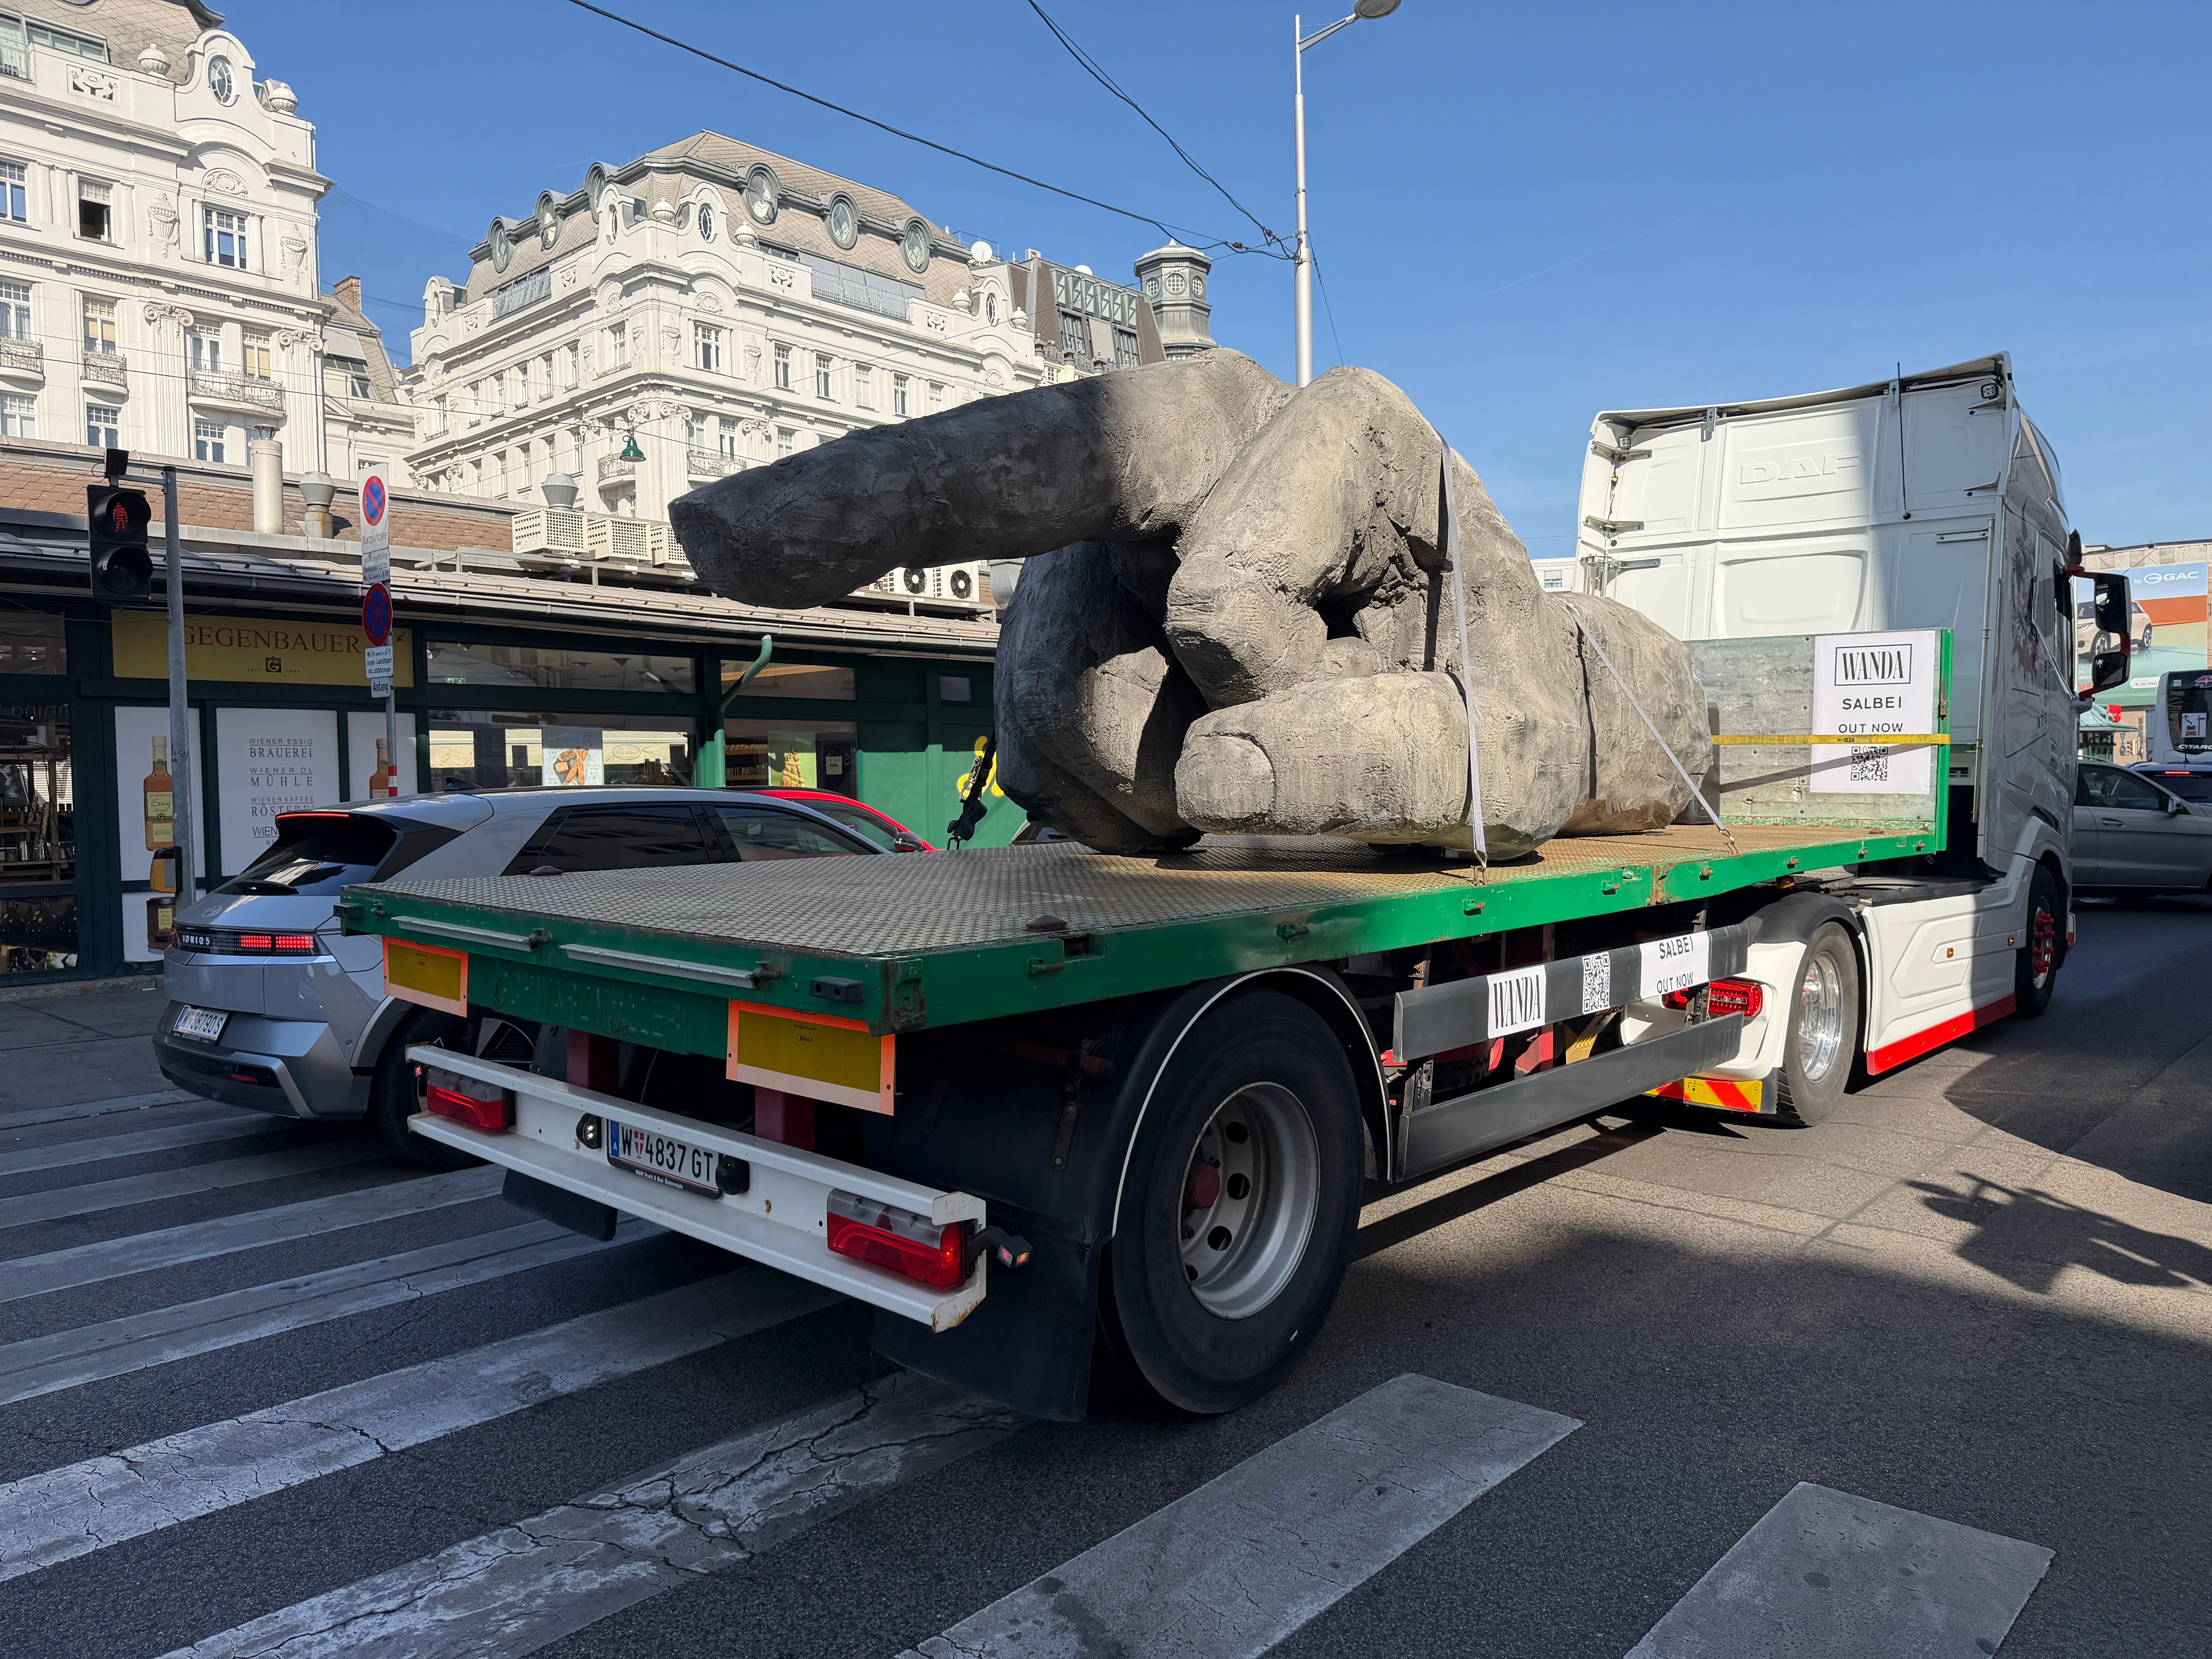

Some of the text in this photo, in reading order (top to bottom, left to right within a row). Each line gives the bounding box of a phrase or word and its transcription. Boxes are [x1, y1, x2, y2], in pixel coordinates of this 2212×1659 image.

[1740, 451, 1860, 484] DAF
[2164, 571, 2198, 581] GAC
[184, 625, 362, 653] GEGENBAUER
[1842, 651, 1903, 680] WANDA
[373, 682, 388, 693] Anfang
[1842, 696, 1901, 710] SALBEI
[1839, 723, 1903, 733] OUT NOW
[250, 747, 312, 757] BRAUEREI
[251, 774, 313, 787] MÜHLE
[151, 798, 171, 809] Essig
[183, 935, 210, 945] IONIQ 5
[1659, 936, 1694, 960] SALBEI
[1657, 972, 1694, 994] OUT NOW
[1493, 975, 1541, 1029] WANDA
[181, 1010, 192, 1028] W
[214, 1017, 223, 1034] S
[613, 1142, 617, 1151] A
[622, 1126, 713, 1182] W 4837 GT
